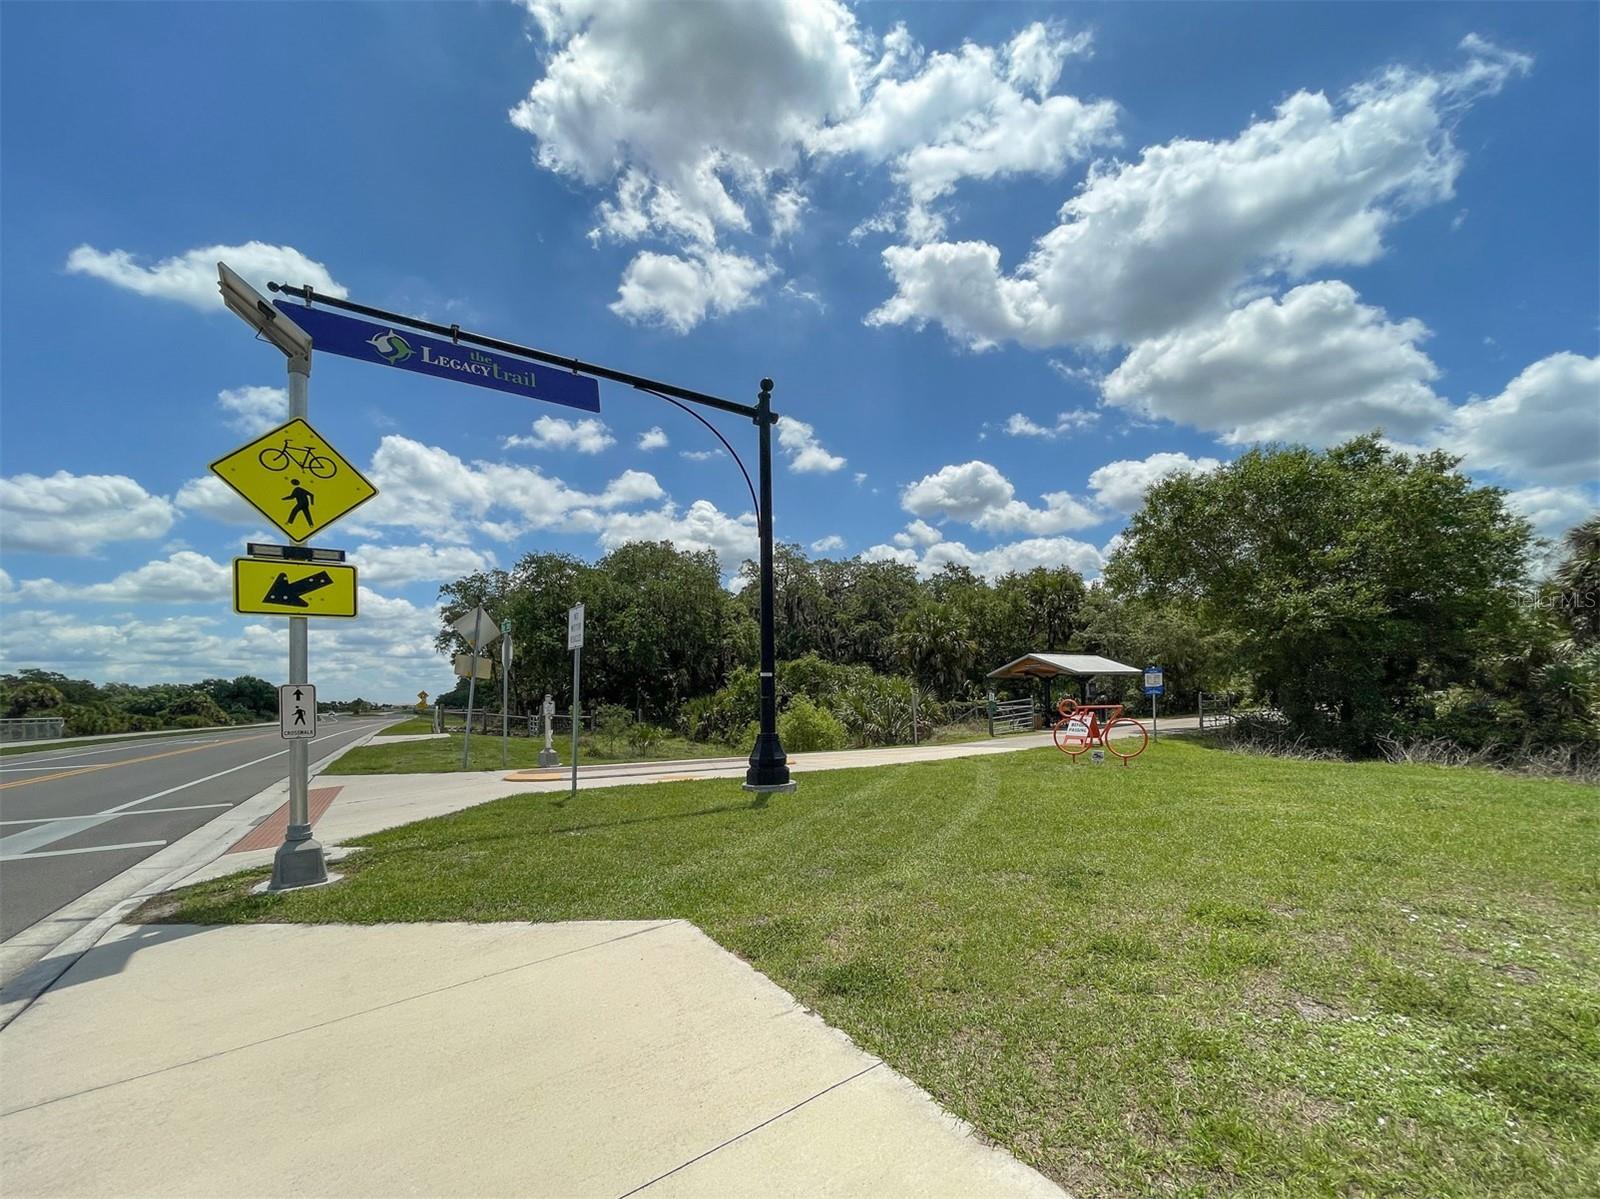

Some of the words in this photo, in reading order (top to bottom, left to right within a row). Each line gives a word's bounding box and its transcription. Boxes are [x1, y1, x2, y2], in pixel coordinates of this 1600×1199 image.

[420, 345, 491, 376] LEGACY
[492, 363, 536, 387] trail
[470, 351, 492, 364] the
